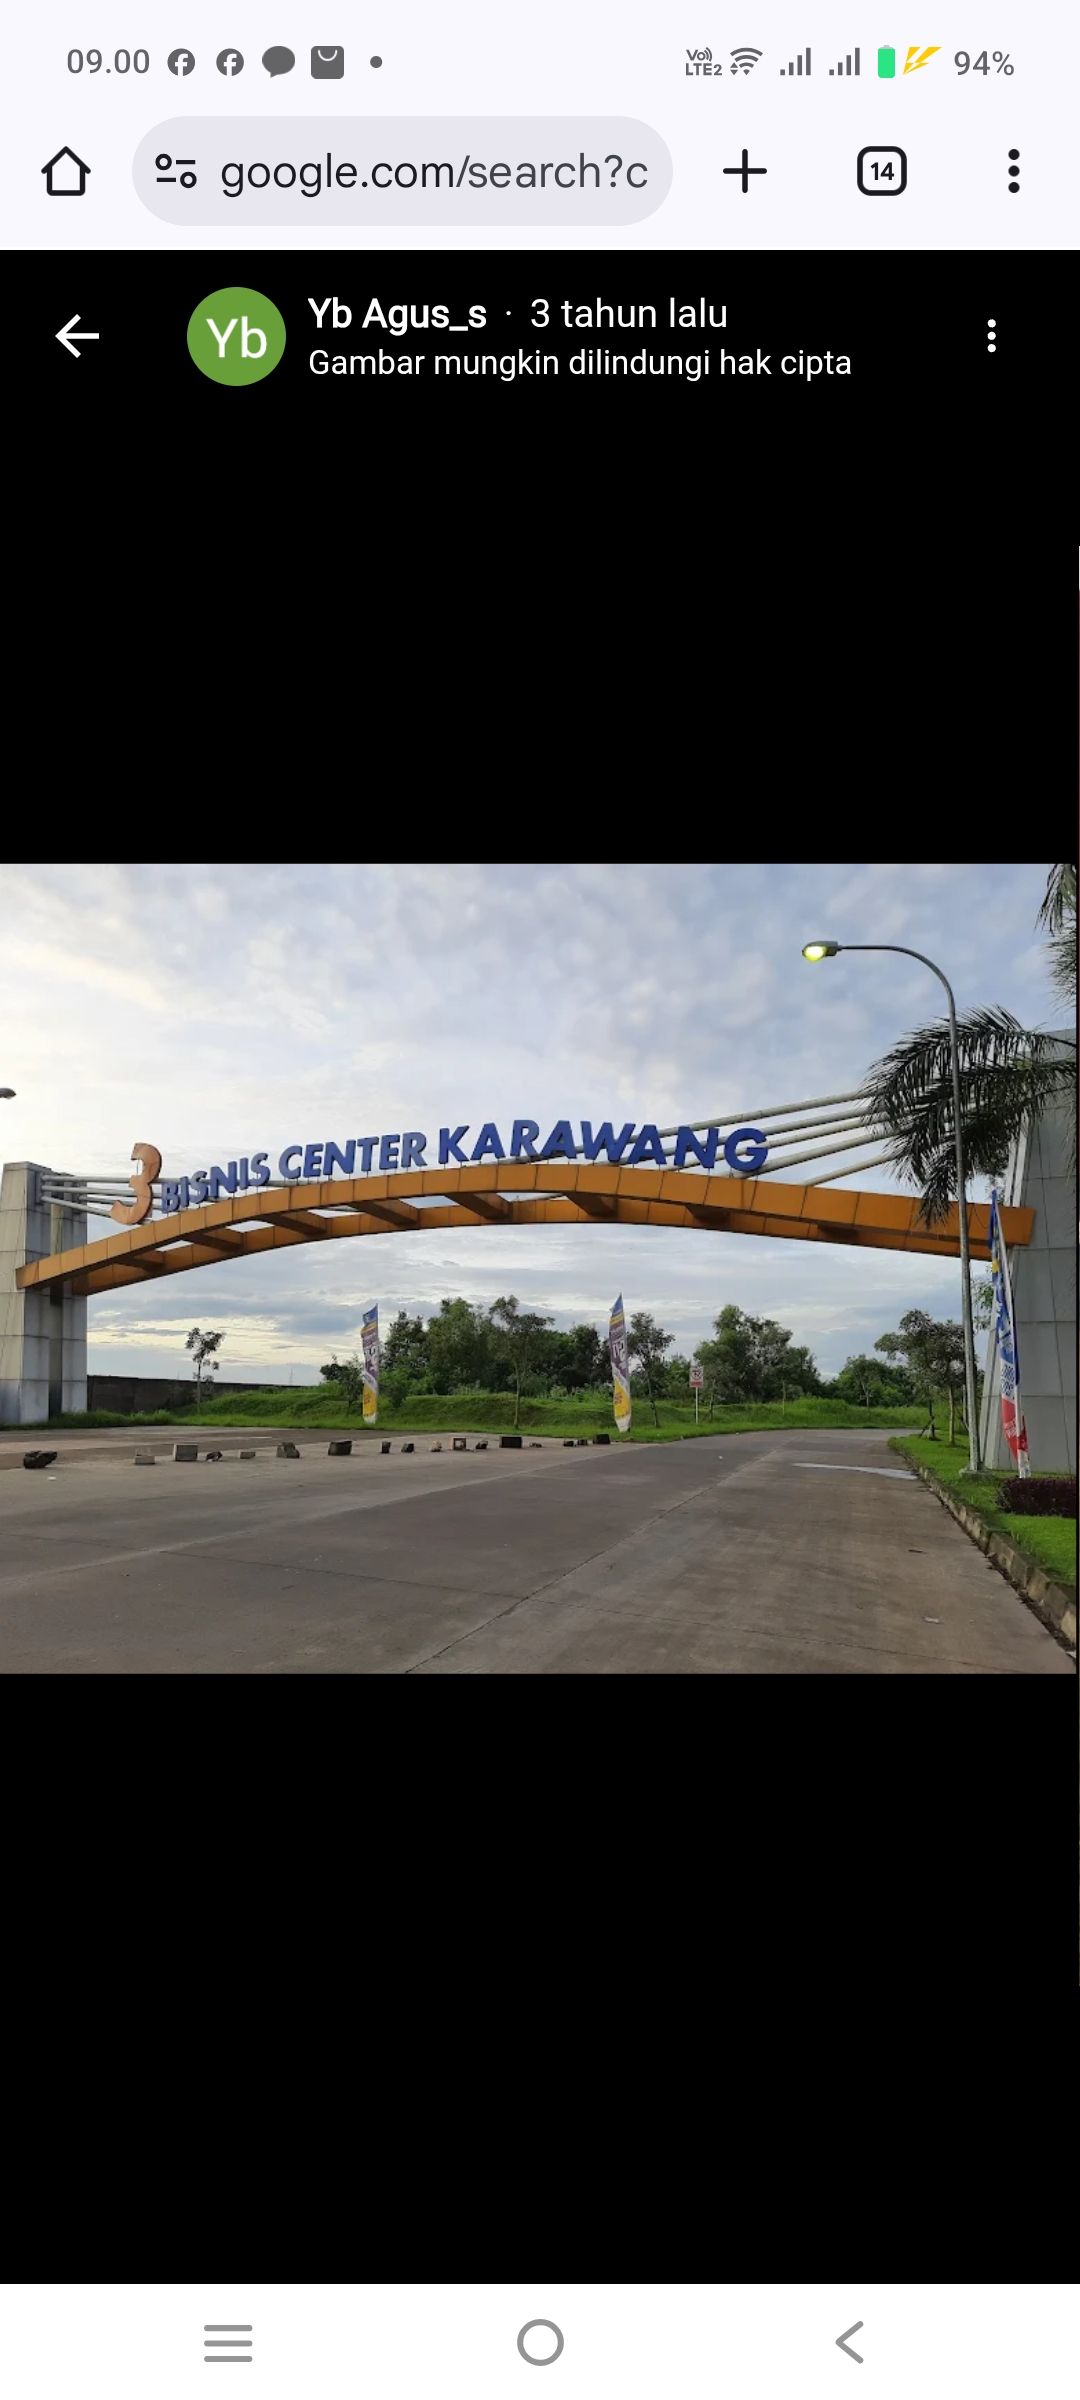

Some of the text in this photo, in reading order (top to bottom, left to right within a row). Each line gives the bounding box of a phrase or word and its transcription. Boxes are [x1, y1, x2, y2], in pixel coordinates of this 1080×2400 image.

[110, 1119, 769, 1225] 3 BISNIS CENTER KARAWANG
